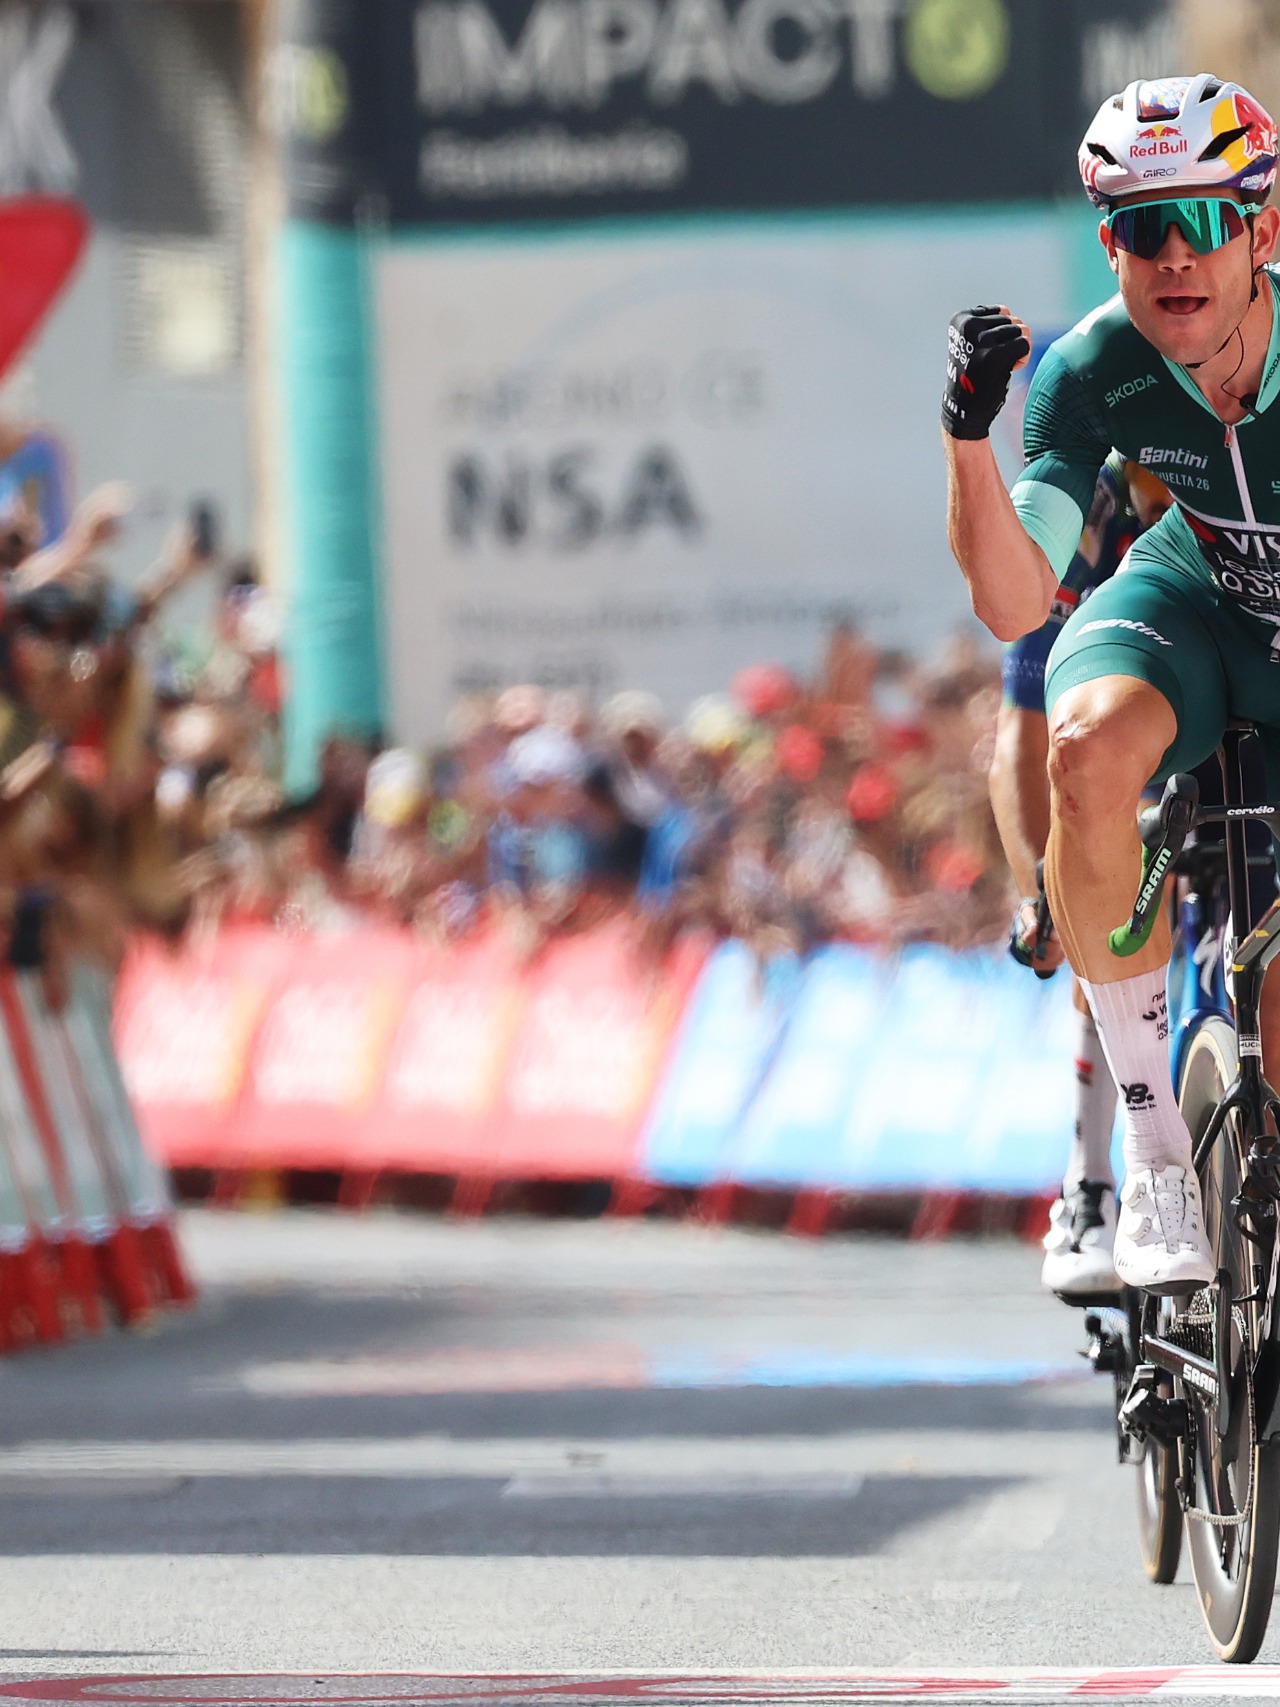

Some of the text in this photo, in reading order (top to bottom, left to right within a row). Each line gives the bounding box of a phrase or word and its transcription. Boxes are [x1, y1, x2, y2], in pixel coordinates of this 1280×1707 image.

[1129, 140, 1188, 158] Red Bull
[1143, 167, 1177, 178] GIRO
[1138, 446, 1209, 470] Santini
[1195, 477, 1210, 491] 26
[1226, 804, 1275, 816] cervélo
[1135, 847, 1172, 915] SRAM
[1182, 1362, 1216, 1395] SRAM
